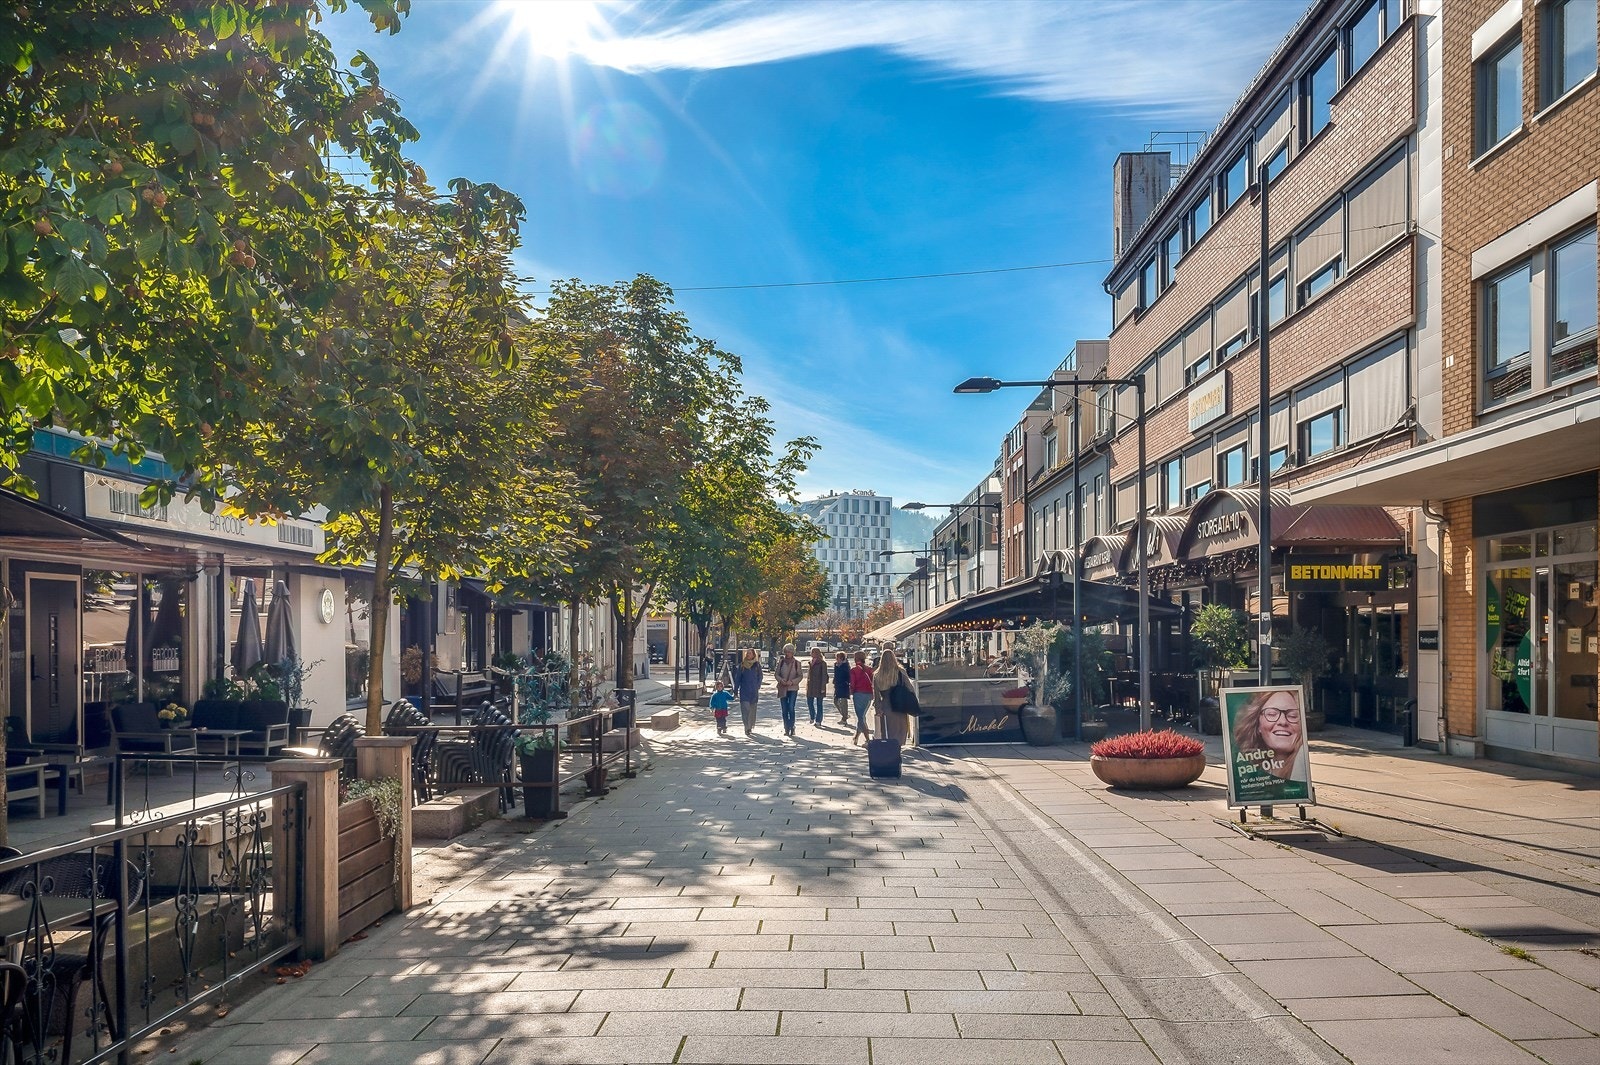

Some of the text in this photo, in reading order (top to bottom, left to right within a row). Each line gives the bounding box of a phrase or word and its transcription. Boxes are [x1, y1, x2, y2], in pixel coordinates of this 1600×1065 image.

[209, 513, 245, 537] BARCODE
[1197, 511, 1240, 539] STORGATA 10
[1291, 565, 1382, 579] BETONMAST
[1506, 587, 1529, 605] Super
[96, 648, 126, 661] BARCODE
[152, 647, 179, 661] BARCODE
[959, 714, 1009, 735] Mirabel
[1236, 749, 1275, 763] Andre
[1237, 764, 1259, 778] par
